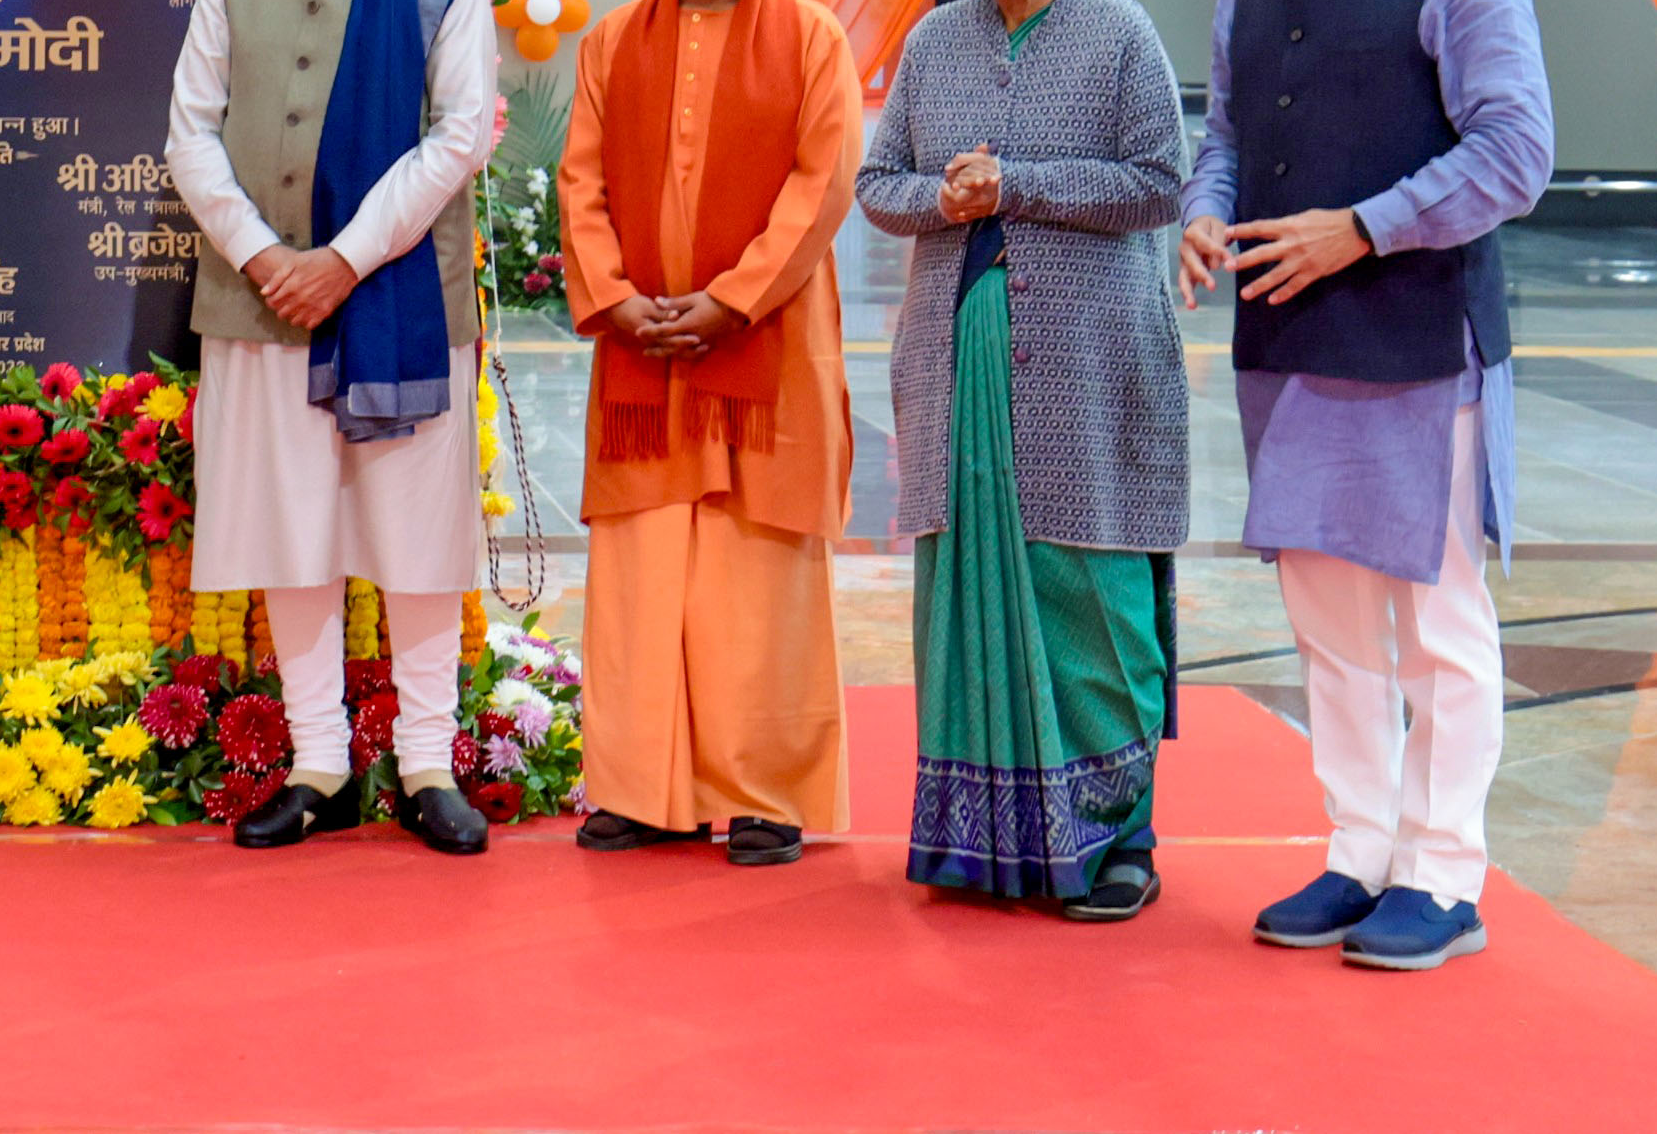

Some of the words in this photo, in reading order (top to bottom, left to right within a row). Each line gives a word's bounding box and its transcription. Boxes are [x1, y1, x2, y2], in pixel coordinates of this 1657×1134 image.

[57, 153, 98, 193] श्री
[77, 196, 108, 217] मंत्री,
[115, 196, 136, 215] रेल
[87, 221, 125, 259] श्री
[127, 223, 202, 261] ब्रजेश
[14, 331, 46, 352] प्रदेश
